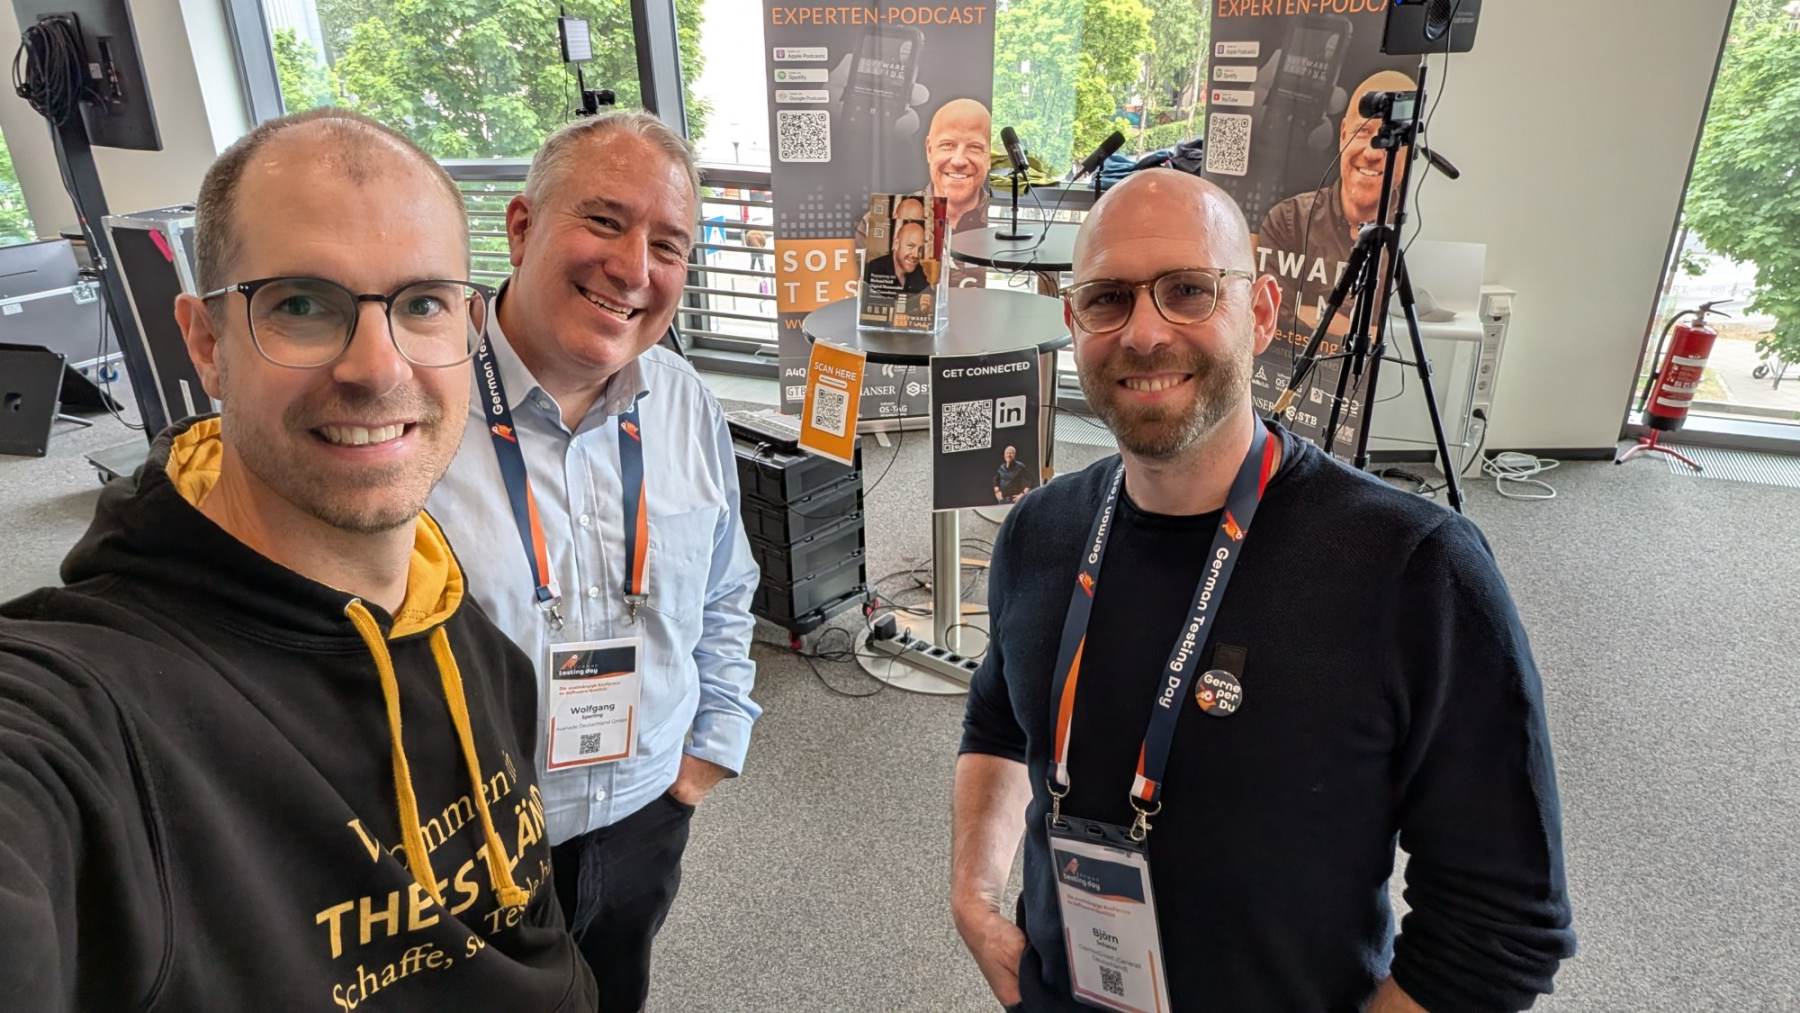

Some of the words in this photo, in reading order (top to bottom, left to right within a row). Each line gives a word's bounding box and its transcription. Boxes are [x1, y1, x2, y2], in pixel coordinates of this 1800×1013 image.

[772, 7, 986, 25] EXPERTEN-PODCAST
[814, 361, 834, 375] SCAN
[835, 367, 857, 382] HERE
[942, 369, 963, 378] GET
[967, 361, 1031, 377] CONNECTED
[484, 361, 504, 415] German
[862, 385, 896, 396] ANSER
[1088, 505, 1112, 564] German
[1197, 547, 1229, 611] German
[1170, 615, 1205, 672] Testing
[1158, 676, 1181, 709] Day
[1203, 673, 1241, 694] Gerne
[1215, 689, 1239, 702] per
[1218, 699, 1236, 713] Du
[570, 703, 616, 715] Wolfgang
[1092, 927, 1119, 945] Björn
[332, 942, 454, 1013] Schaffe,
